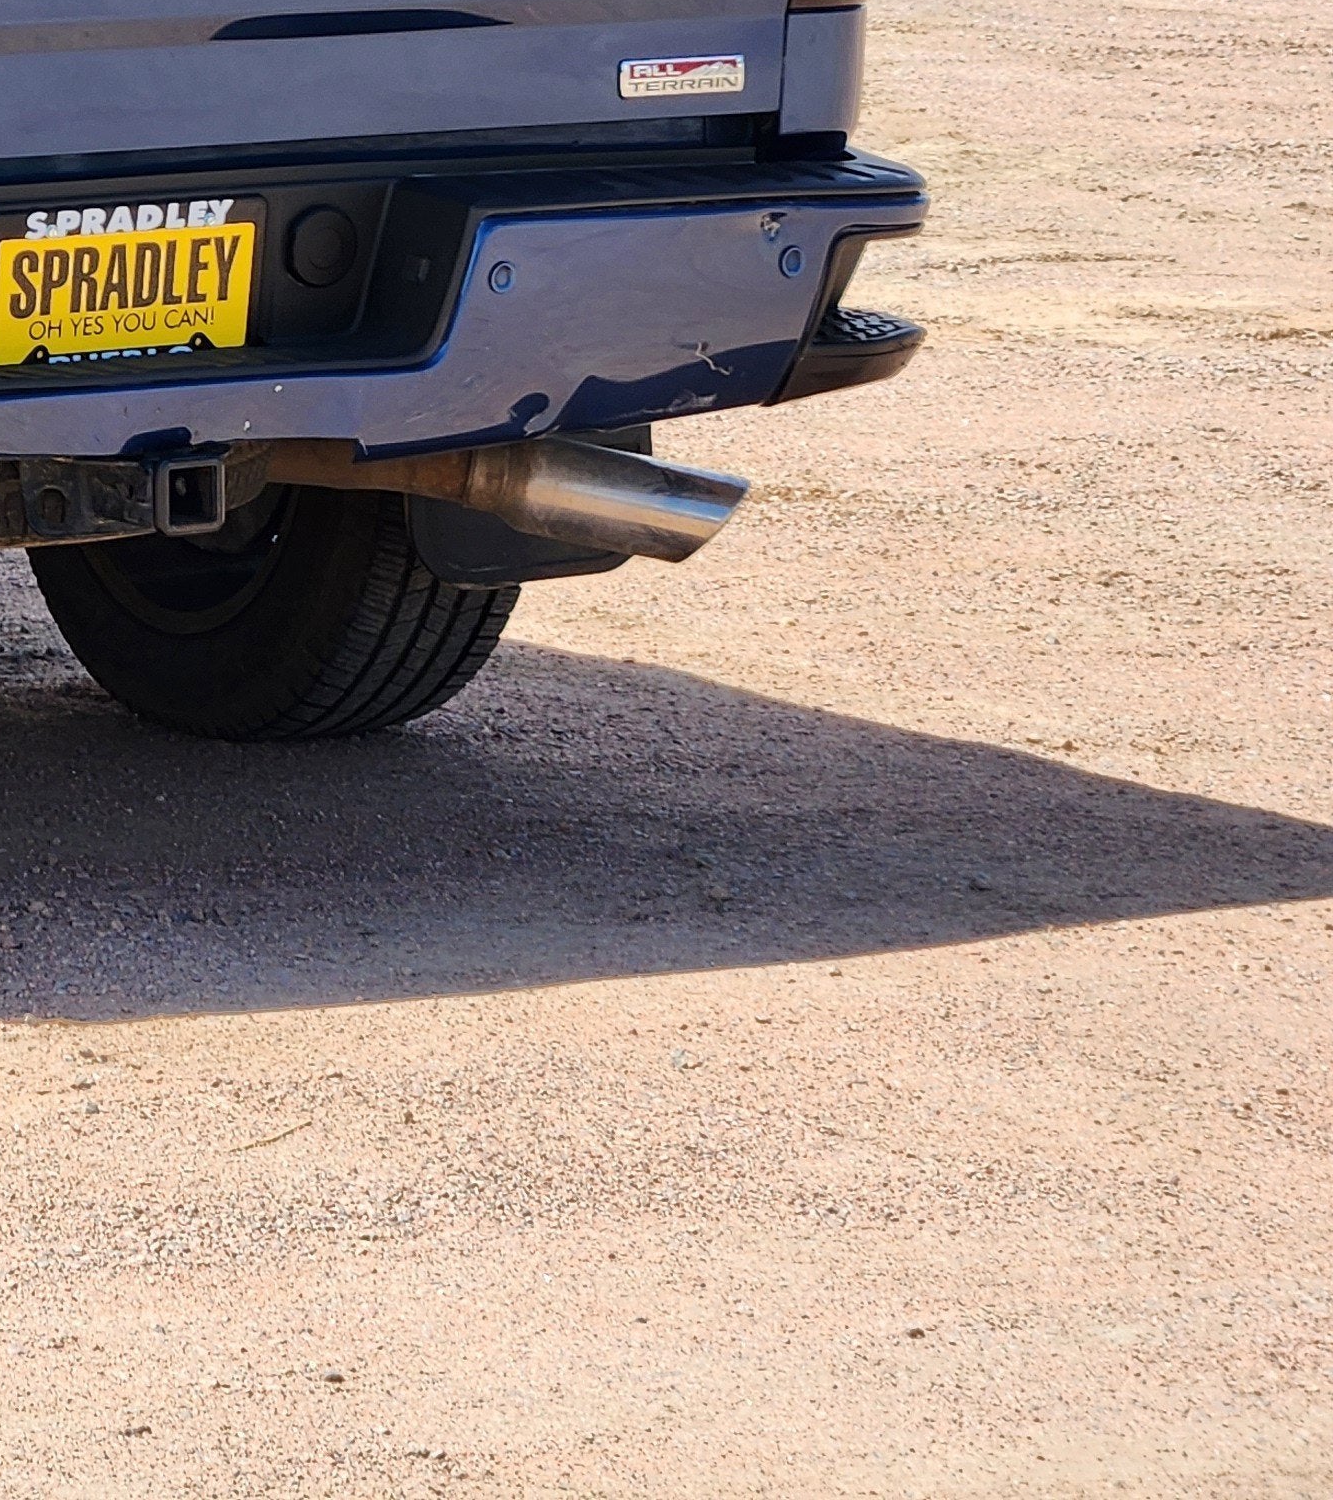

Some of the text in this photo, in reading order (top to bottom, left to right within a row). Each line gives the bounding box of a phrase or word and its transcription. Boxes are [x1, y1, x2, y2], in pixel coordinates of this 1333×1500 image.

[627, 76, 739, 93] TERRAIN
[632, 62, 682, 78] ALL
[24, 198, 235, 240] SPRADLEY
[9, 234, 242, 319] SPRADLEY
[28, 305, 215, 341] OH YES YOU CAN!
